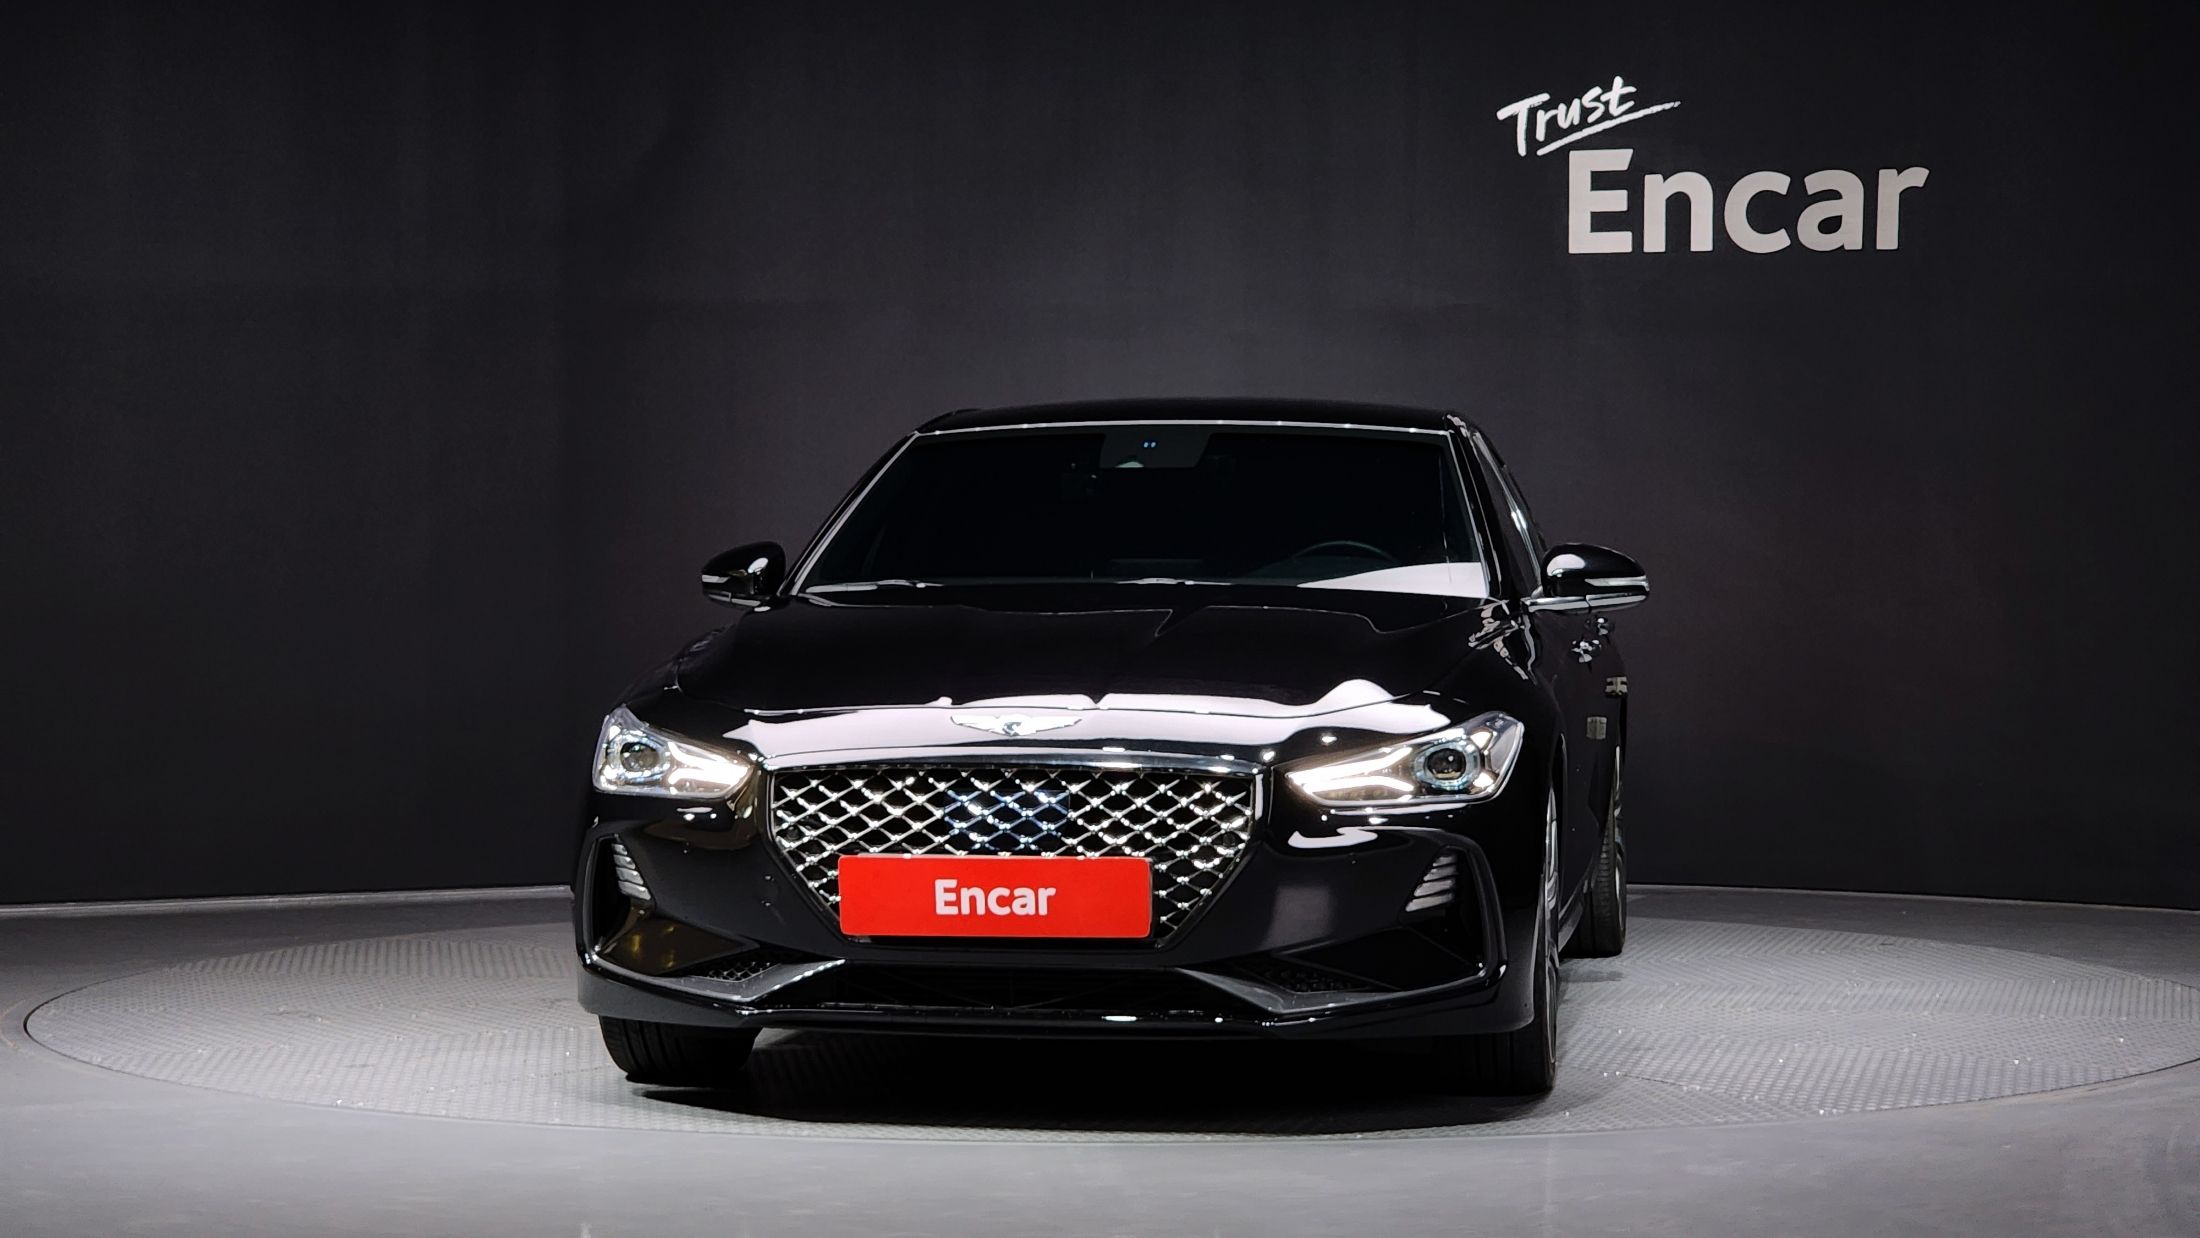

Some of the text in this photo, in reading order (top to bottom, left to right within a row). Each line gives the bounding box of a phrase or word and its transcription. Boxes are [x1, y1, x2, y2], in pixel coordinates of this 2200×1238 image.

[1496, 75, 1638, 157] Trust
[1568, 148, 1930, 254] Encar
[934, 879, 1057, 916] Encar
